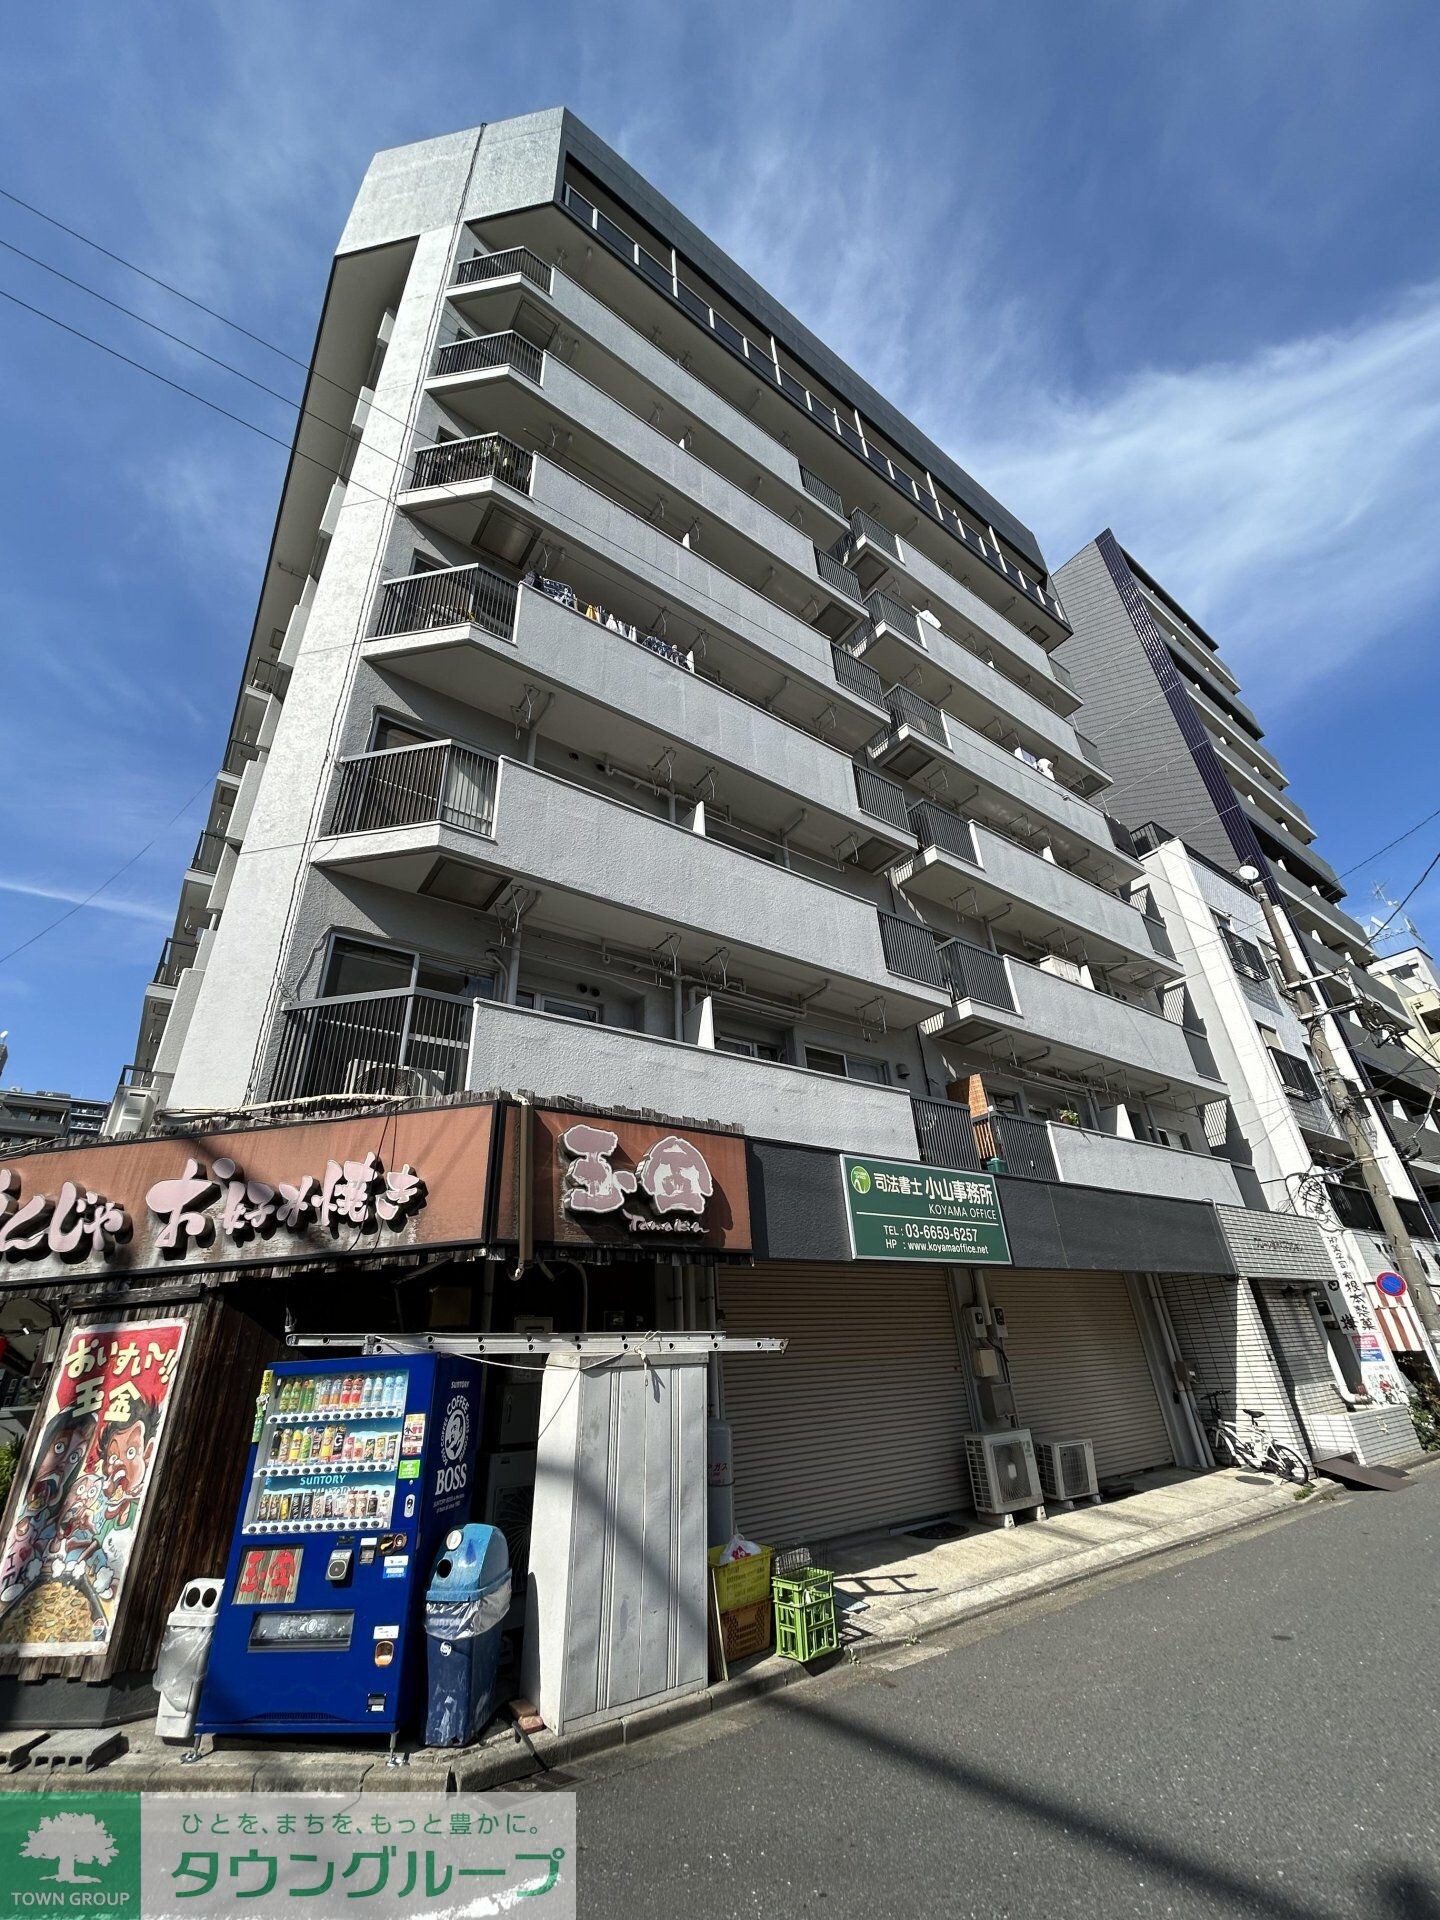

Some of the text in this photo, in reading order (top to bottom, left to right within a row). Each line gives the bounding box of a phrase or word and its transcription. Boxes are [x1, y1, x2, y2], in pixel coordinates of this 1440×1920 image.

[145, 1152, 420, 1249] お好み焼き
[873, 1172, 923, 1196] 司法書士
[925, 1176, 994, 1206] 小山事務所
[928, 1203, 997, 1220] KOYAMA OFFICE
[883, 1224, 899, 1236] TEL
[905, 1223, 978, 1242] 03-6659-6257
[886, 1239, 898, 1249] HP
[908, 1241, 989, 1255] www.koyamaoffice.net
[72, 1376, 142, 1422] 玉金
[434, 1463, 467, 1496] BOSS
